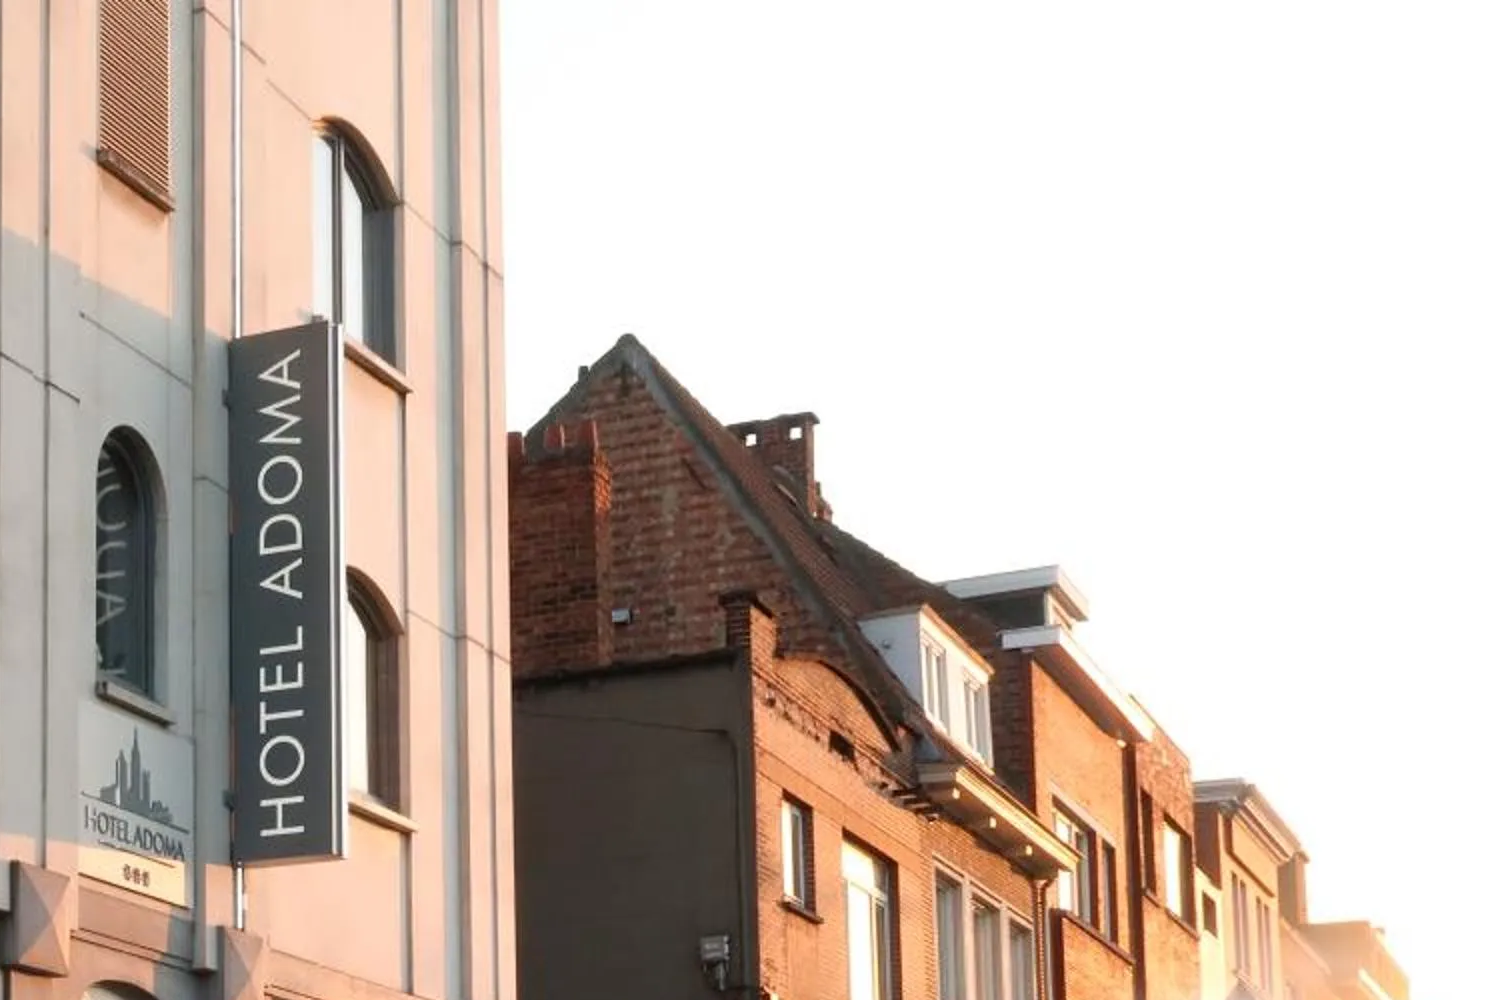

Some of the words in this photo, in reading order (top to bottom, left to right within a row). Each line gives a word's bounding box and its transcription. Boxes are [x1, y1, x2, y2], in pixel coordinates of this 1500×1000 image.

[257, 348, 303, 600] ADOMA
[84, 804, 133, 845] HOTEL
[132, 826, 185, 862] ADOMA
[259, 625, 305, 837] HOTEL
